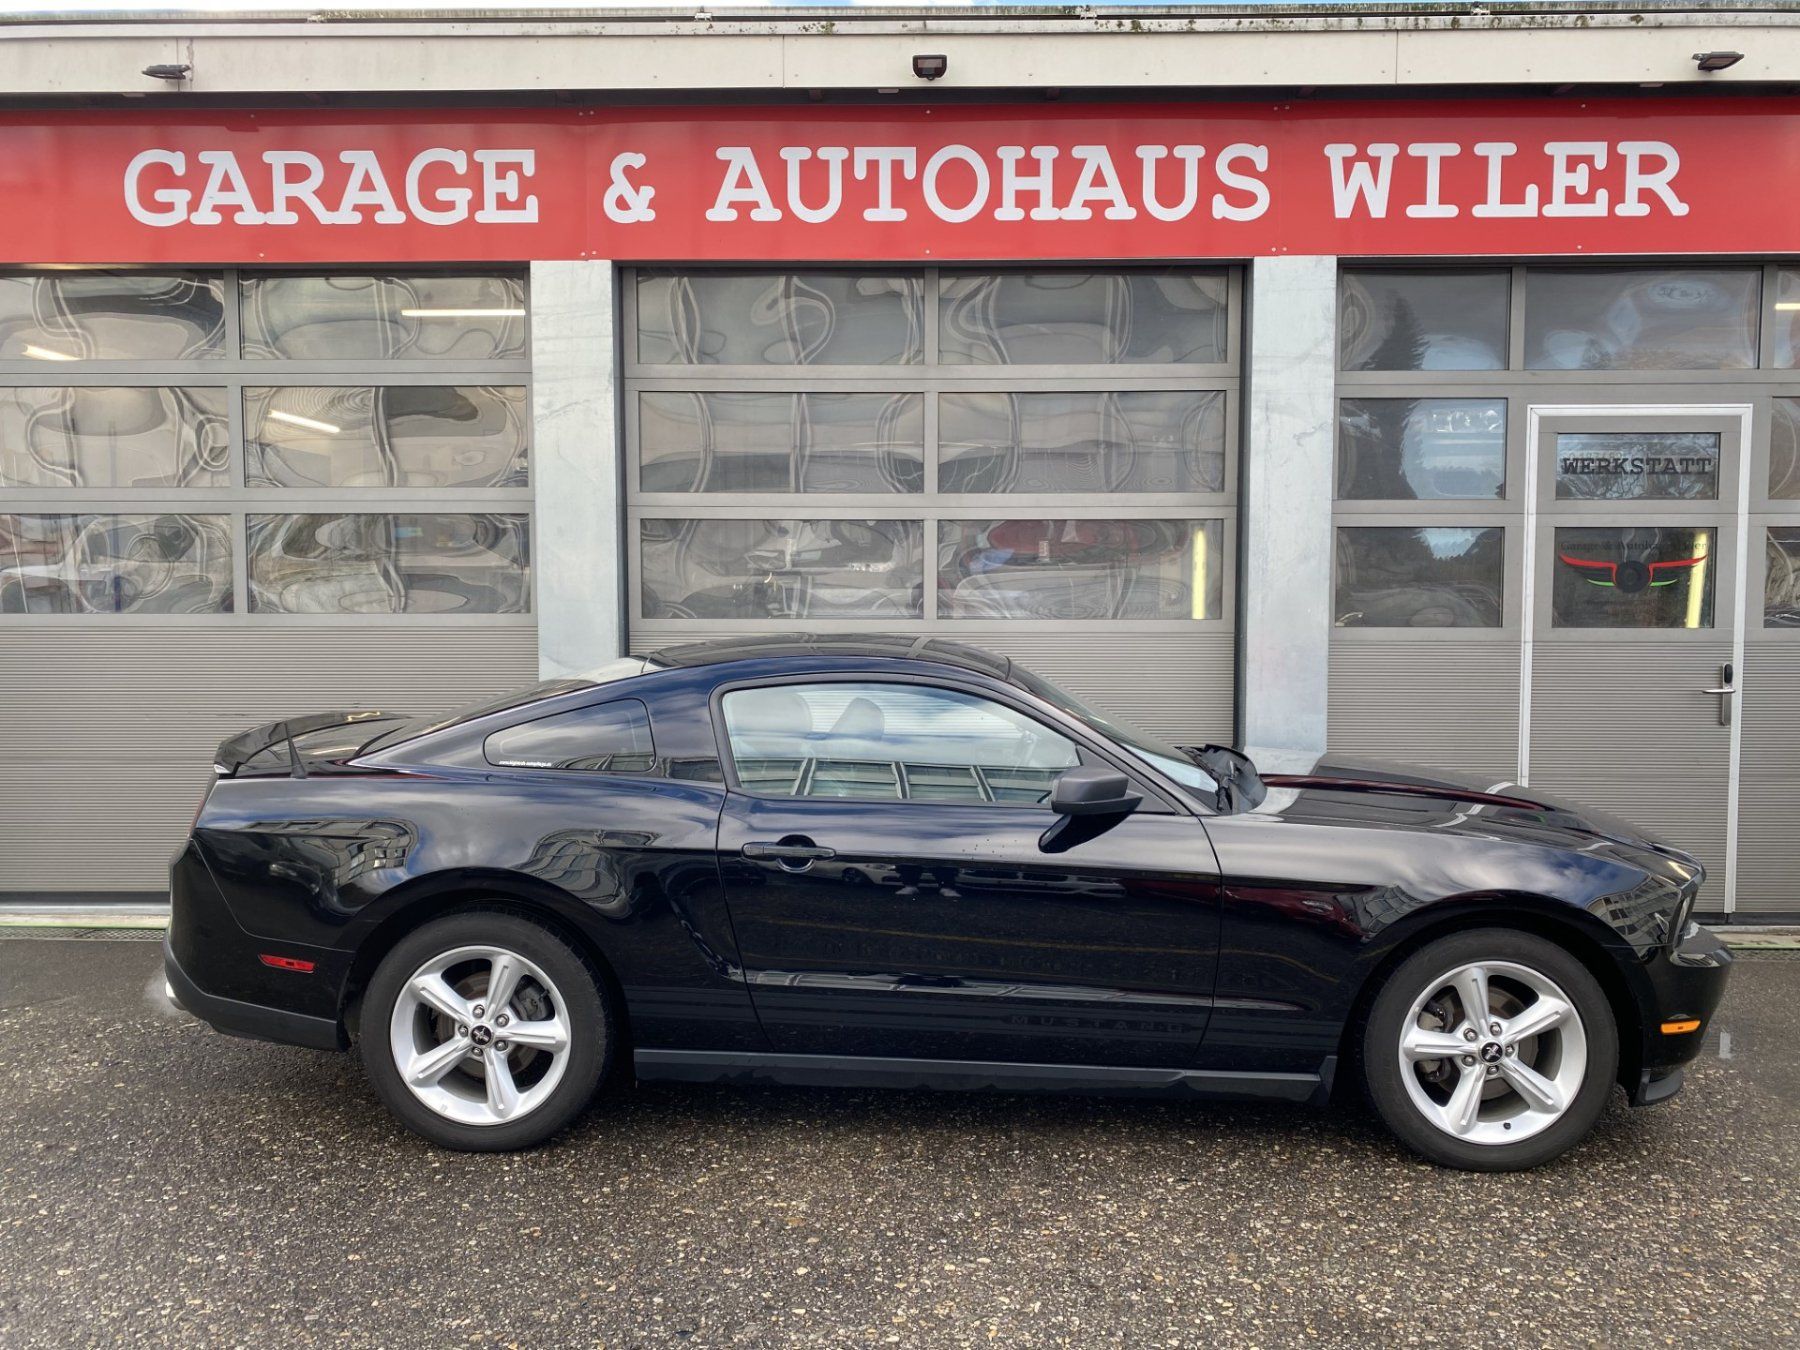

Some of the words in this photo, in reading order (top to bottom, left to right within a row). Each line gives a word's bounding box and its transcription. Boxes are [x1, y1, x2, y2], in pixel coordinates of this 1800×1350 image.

[124, 148, 539, 227] GARAGE
[604, 152, 656, 223] &
[706, 143, 1270, 223] AUTOHAUS
[1324, 141, 1689, 218] WILER
[1562, 457, 1712, 475] WERKSTATT
[1011, 1015, 1184, 1033] MUSTANG
